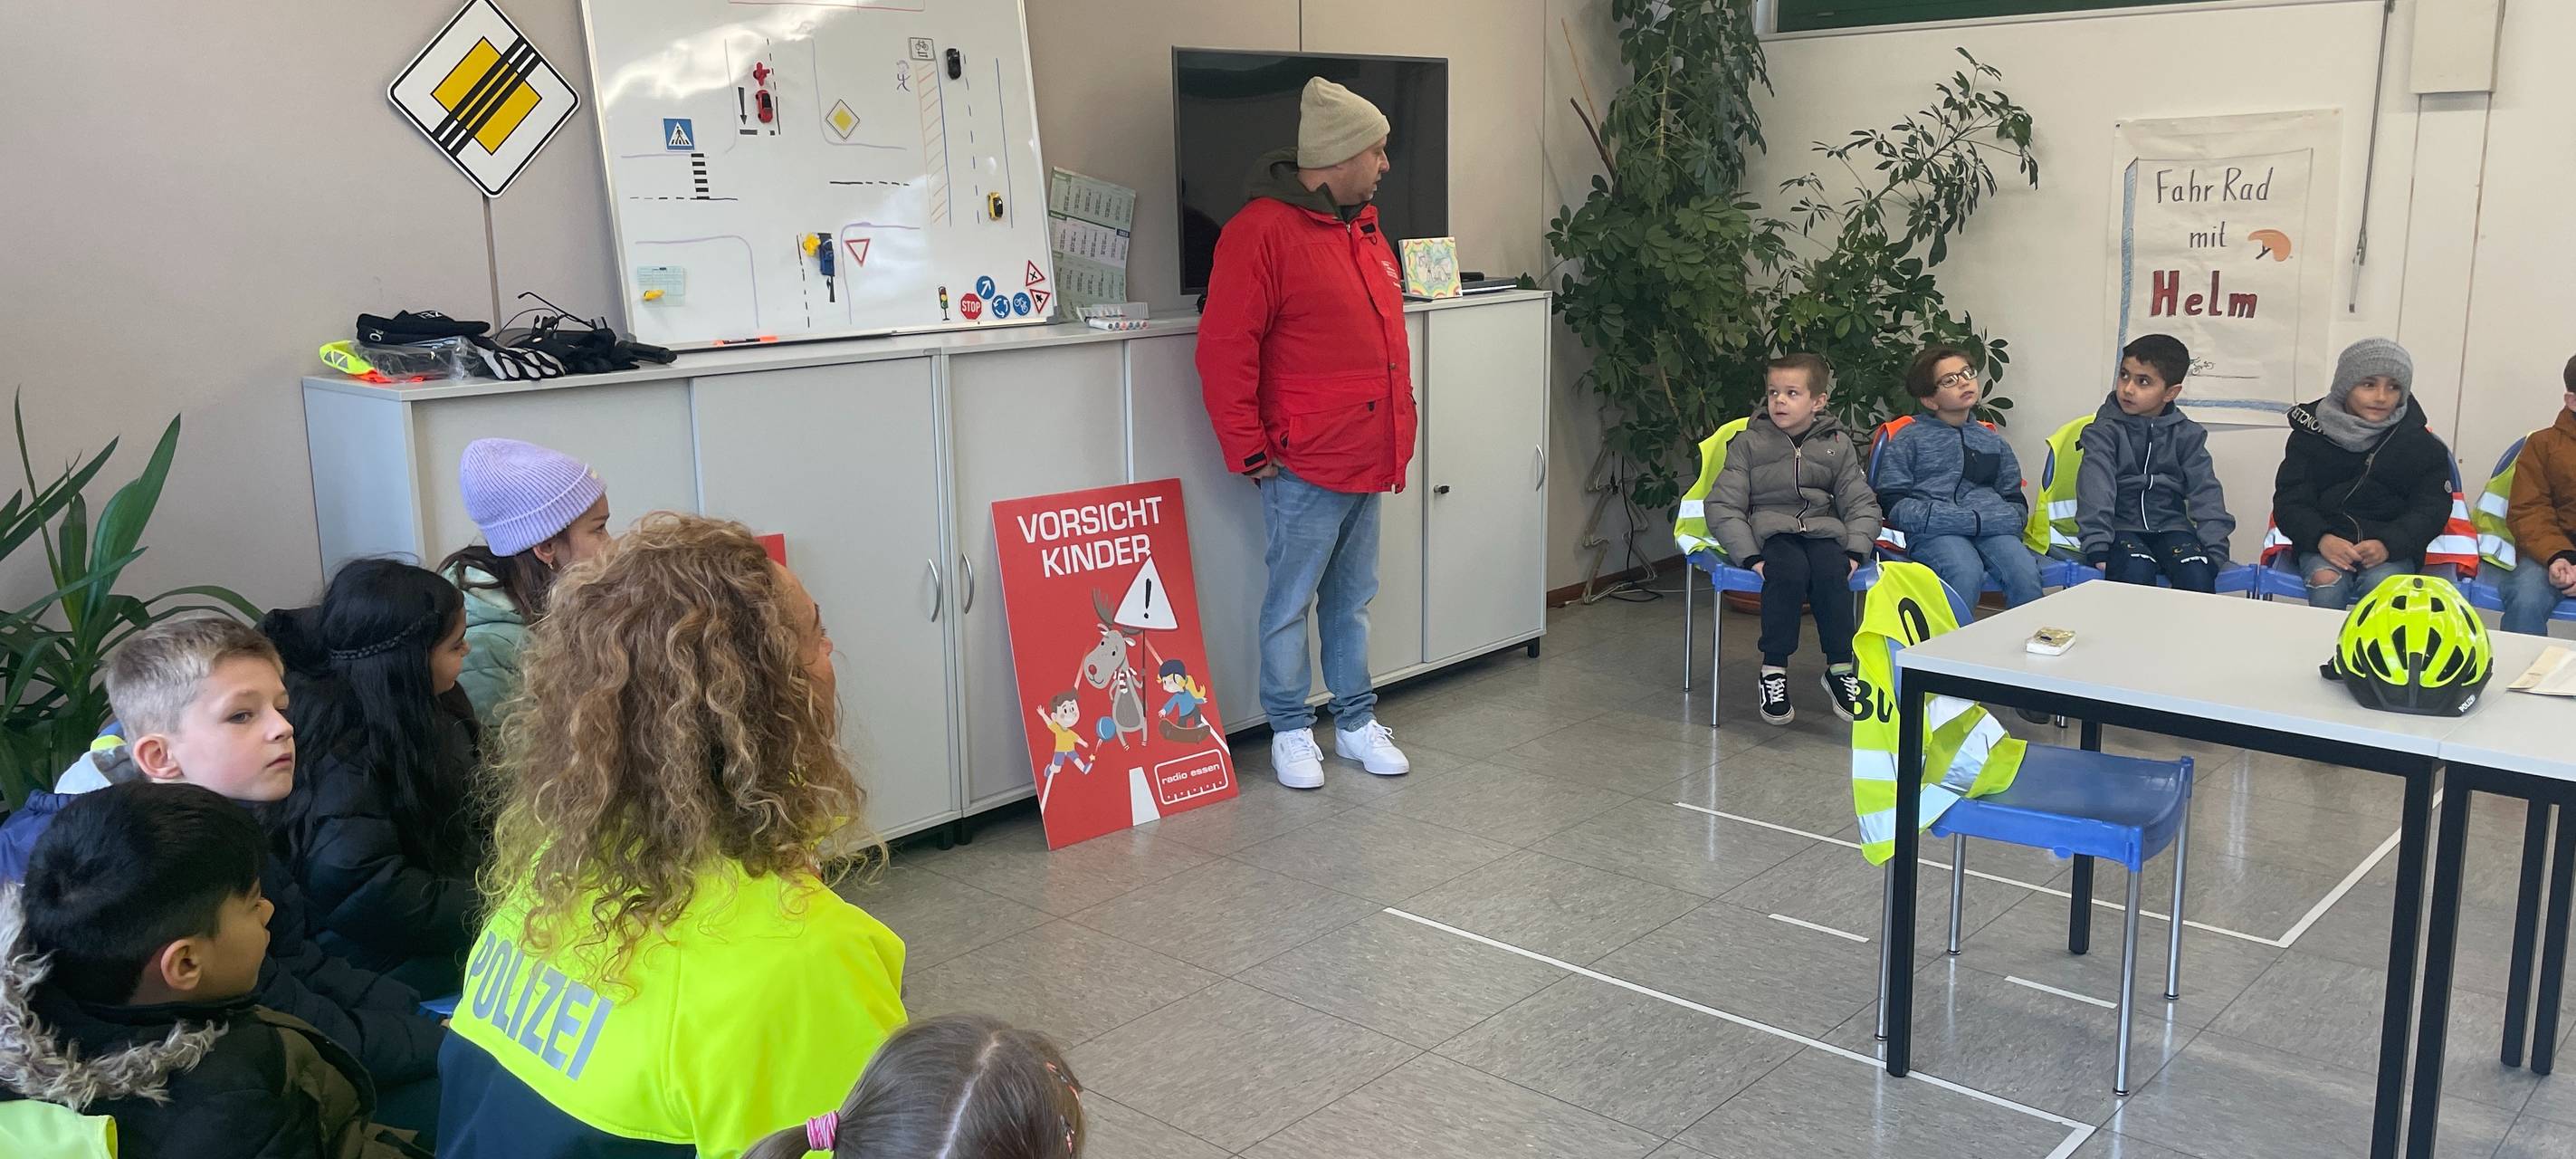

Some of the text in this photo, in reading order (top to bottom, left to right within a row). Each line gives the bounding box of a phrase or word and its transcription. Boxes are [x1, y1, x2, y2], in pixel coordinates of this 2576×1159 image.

[2156, 167, 2274, 203] Fahr Rad
[2190, 221, 2228, 248] mit
[961, 300, 981, 313] STOP
[2150, 270, 2258, 319] Helm
[1017, 496, 1163, 543] VORSICHT
[1041, 534, 1151, 578] KINDER
[1161, 763, 1220, 785] radio essen
[463, 931, 615, 1081] POLIZEI
